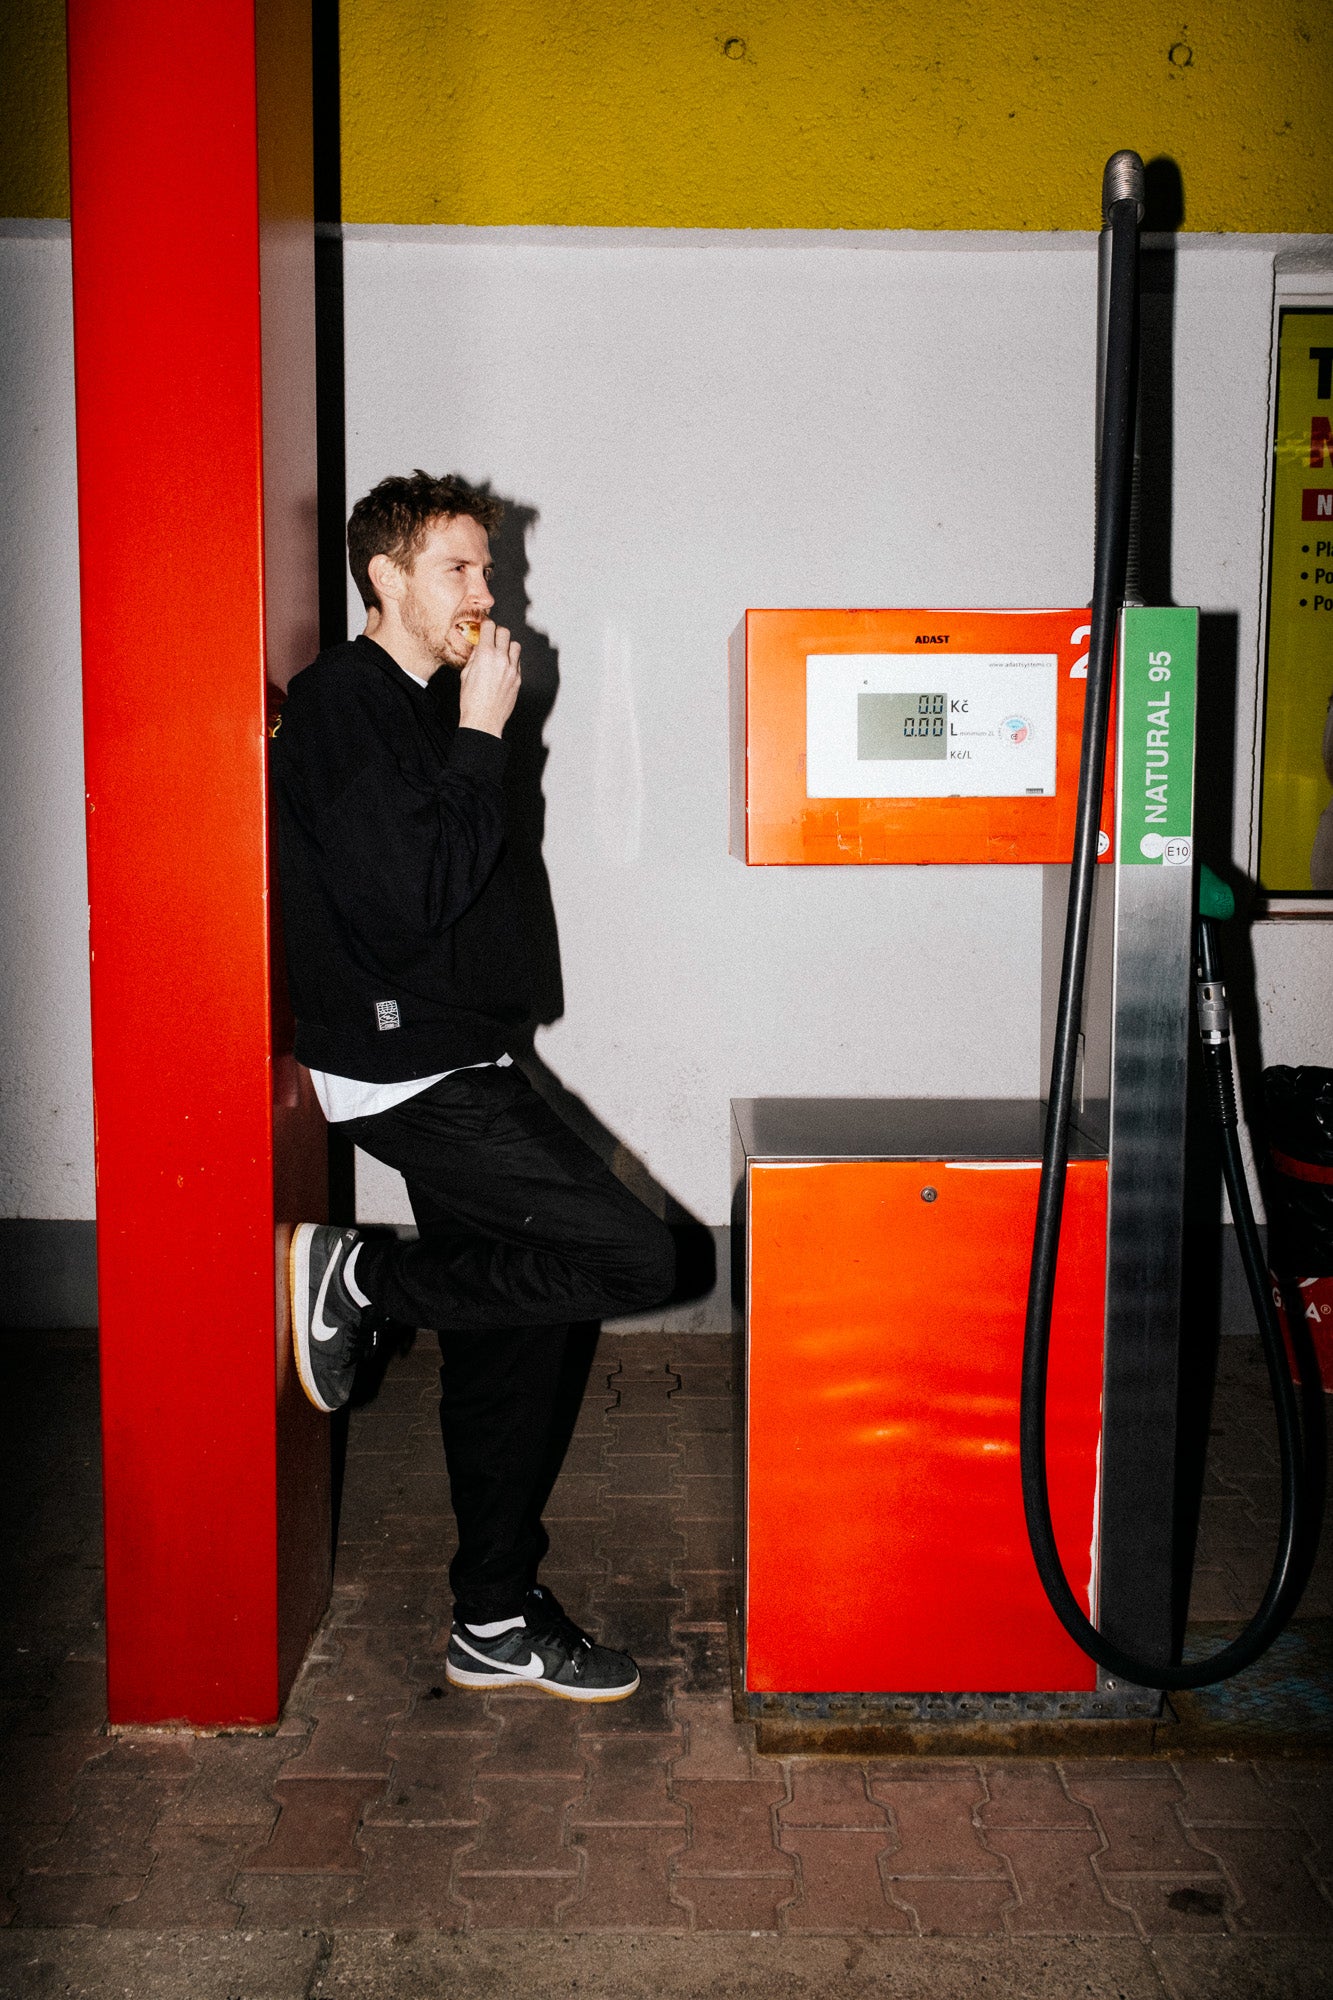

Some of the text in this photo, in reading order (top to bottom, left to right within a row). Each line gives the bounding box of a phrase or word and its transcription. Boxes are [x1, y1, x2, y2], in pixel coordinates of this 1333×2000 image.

[1316, 541, 1333, 557] Pl
[915, 635, 950, 644] ADAST
[1069, 625, 1092, 679] 2
[918, 695, 943, 714] 0.0
[950, 700, 969, 713] Kč
[903, 717, 943, 737] 0.00
[950, 723, 958, 736] L
[1145, 650, 1172, 823] NATURAL 95
[950, 750, 972, 760] Kč/L
[1167, 846, 1189, 857] E10
